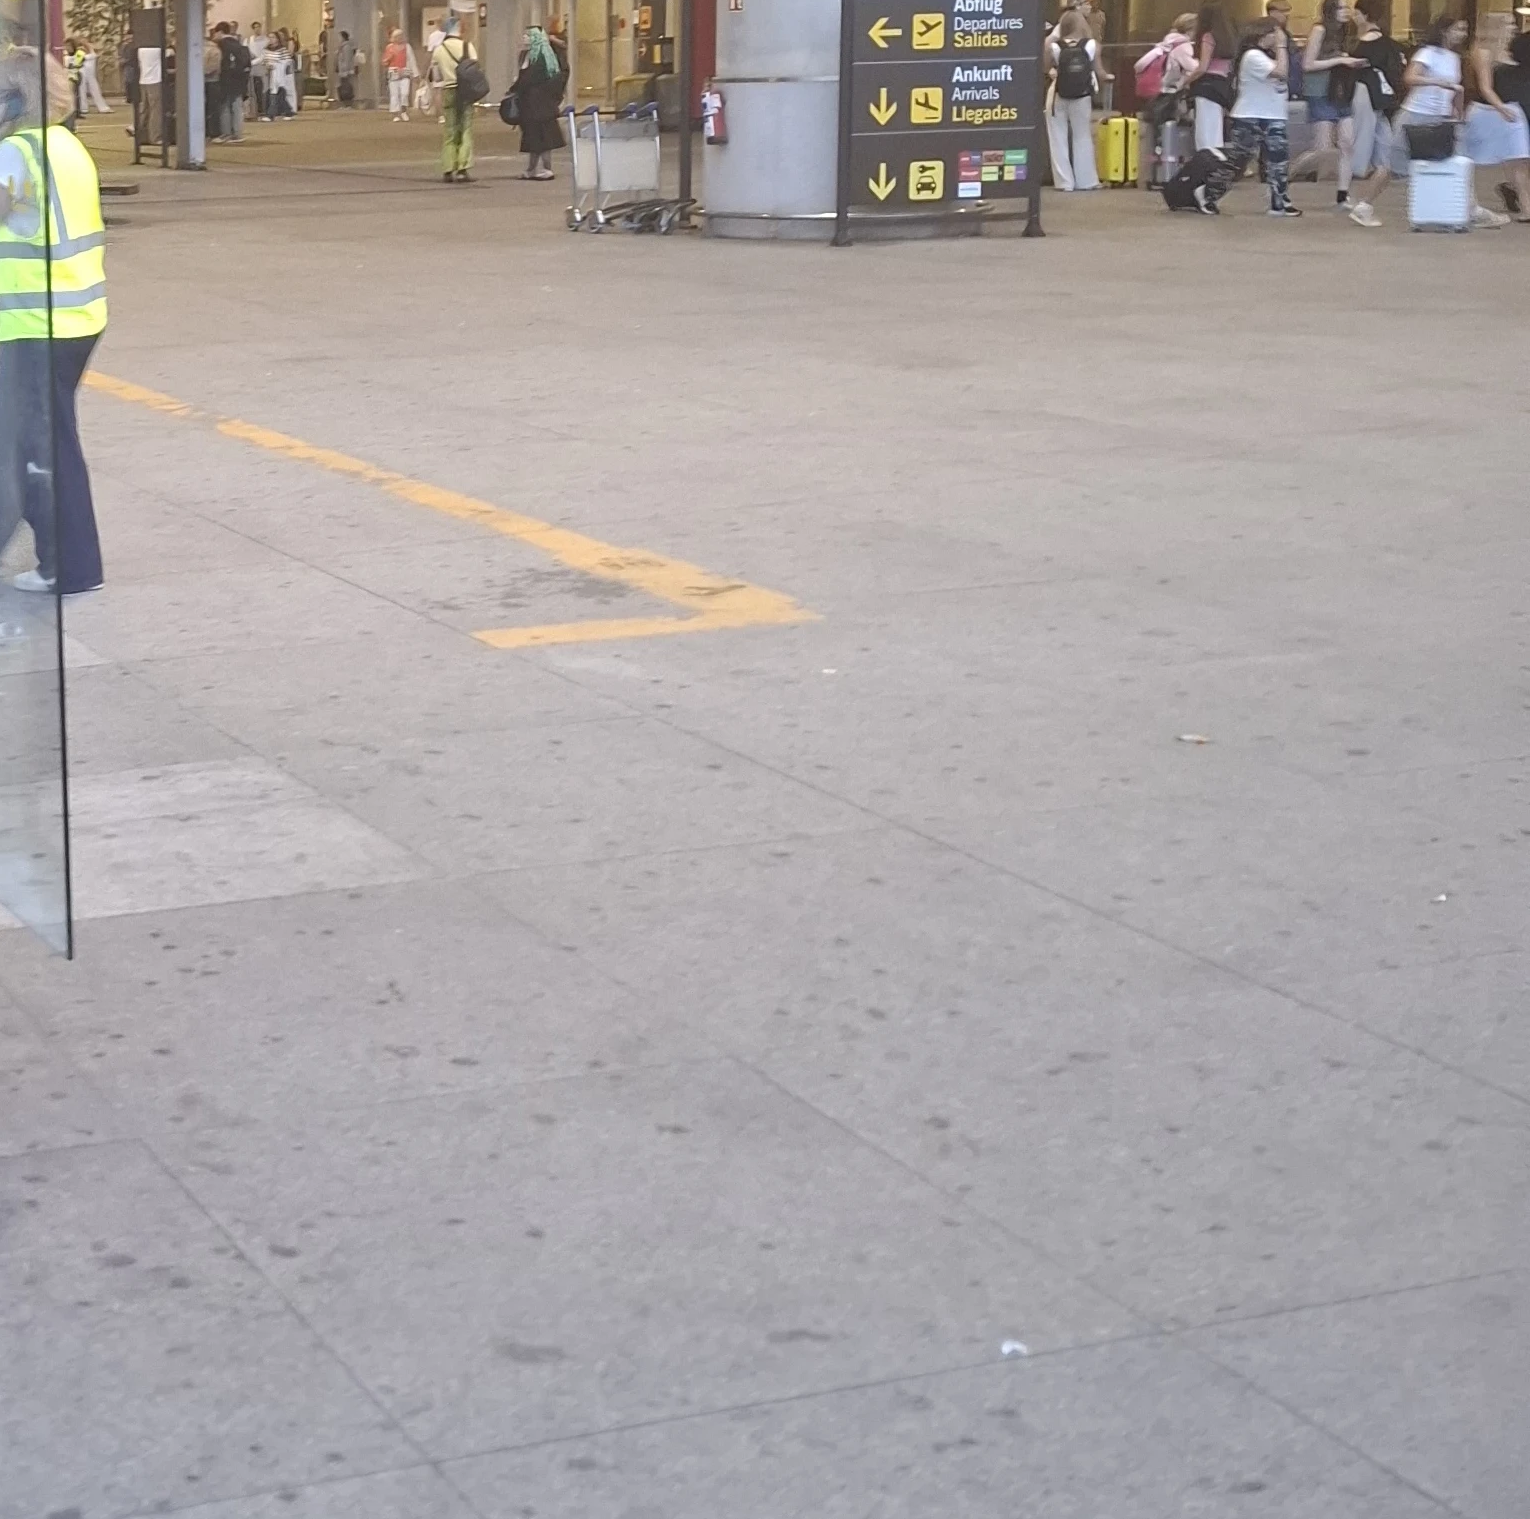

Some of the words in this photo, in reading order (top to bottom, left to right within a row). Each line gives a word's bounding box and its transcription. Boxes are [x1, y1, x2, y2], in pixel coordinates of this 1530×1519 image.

[953, 16, 1023, 32] Departures
[953, 31, 1008, 48] Salidas
[951, 64, 1013, 83] Ankunft
[951, 86, 1000, 102] Arrivals
[952, 104, 1018, 125] Llegadas
